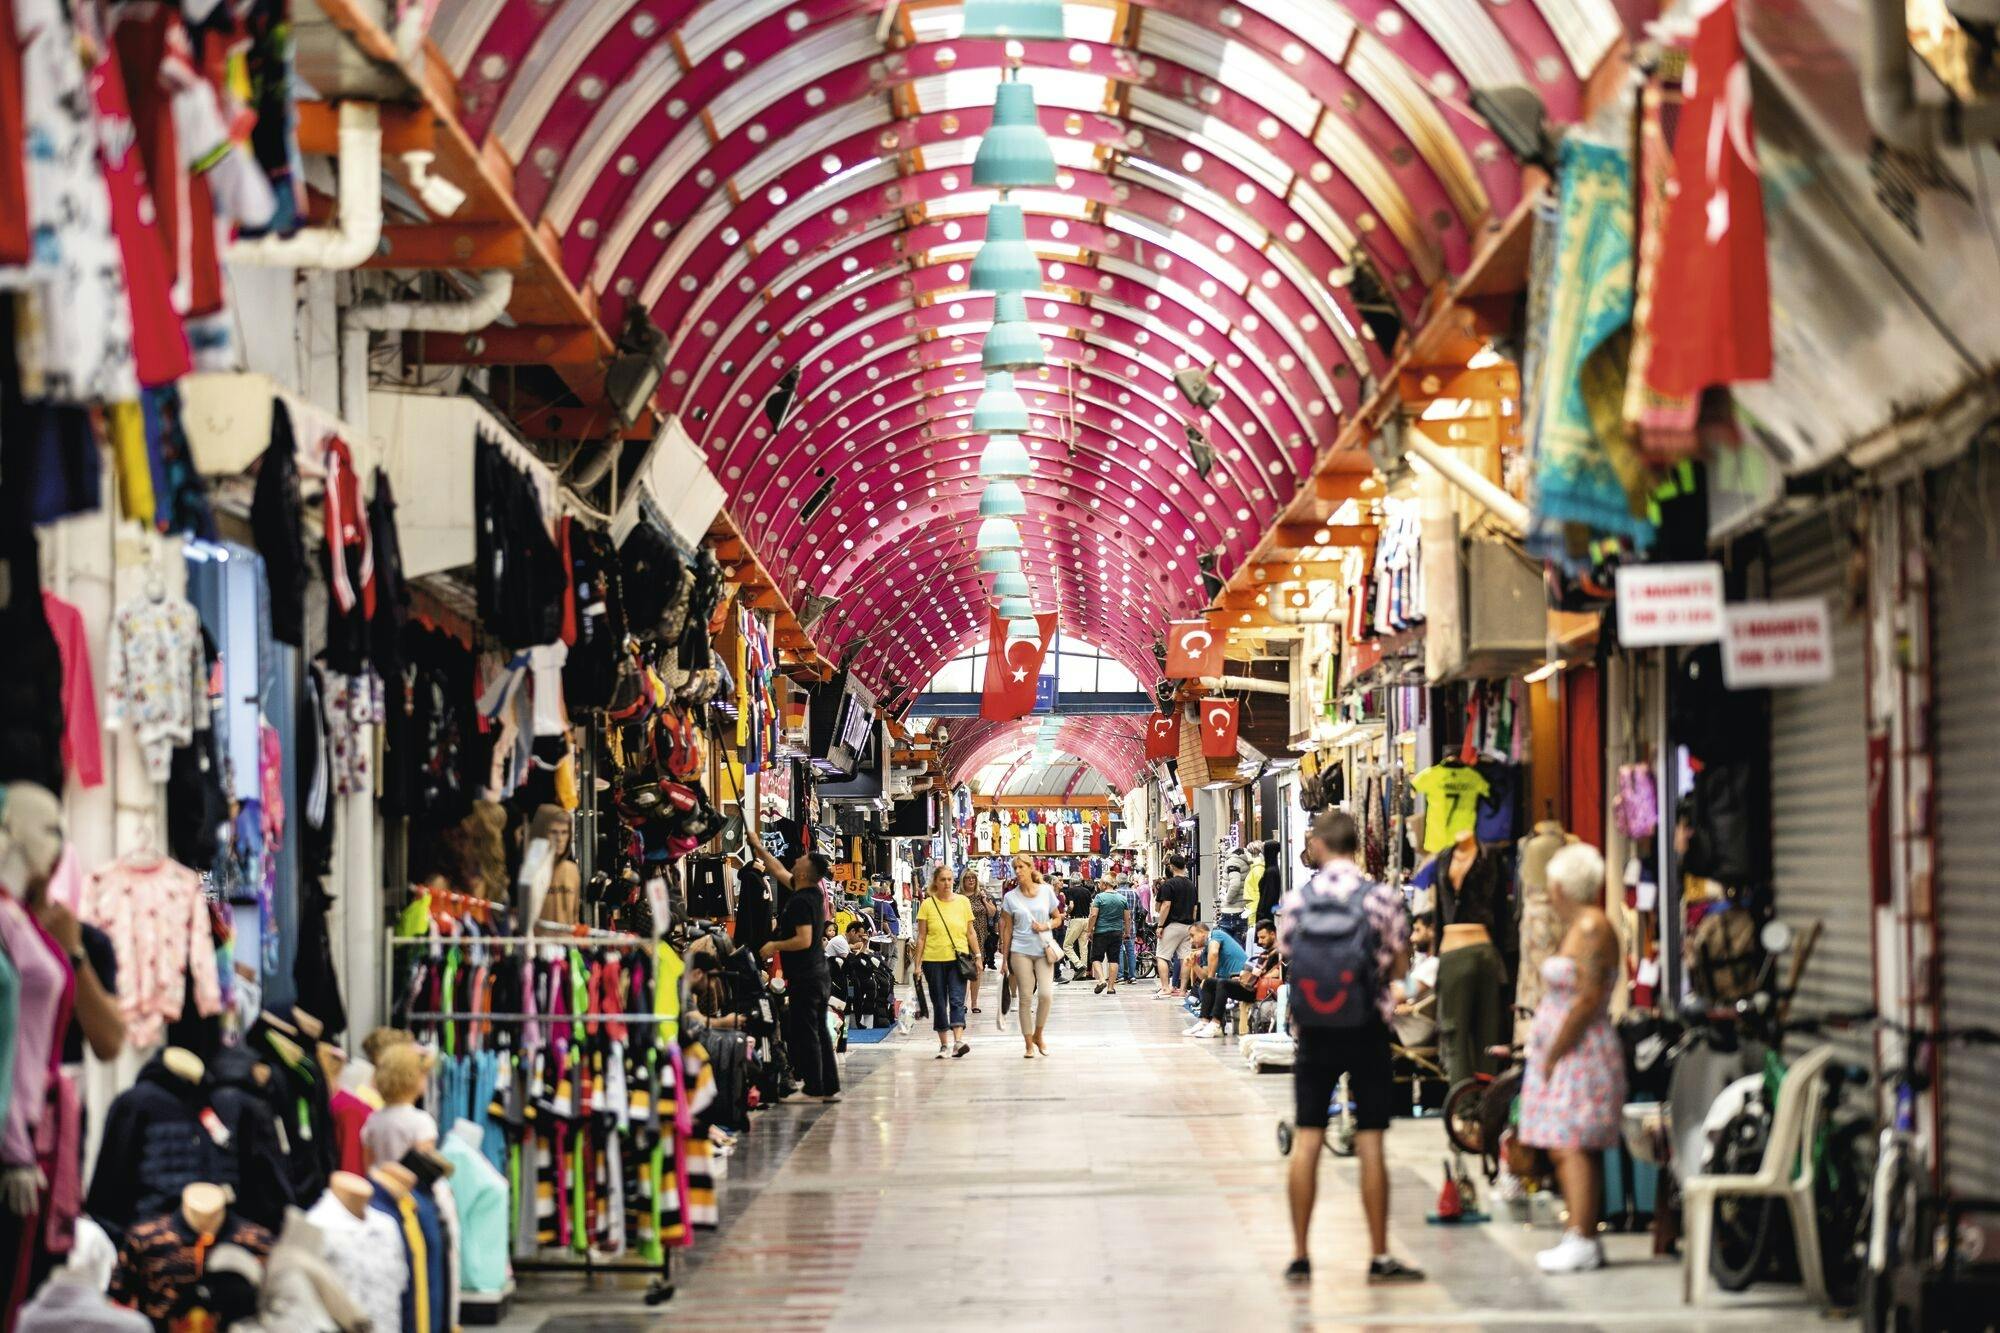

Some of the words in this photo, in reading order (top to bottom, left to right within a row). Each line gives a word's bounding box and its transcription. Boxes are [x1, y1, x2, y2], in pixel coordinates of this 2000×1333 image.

[1445, 793, 1460, 827] 7
[980, 831, 989, 840] 10
[849, 881, 866, 892] 5£
